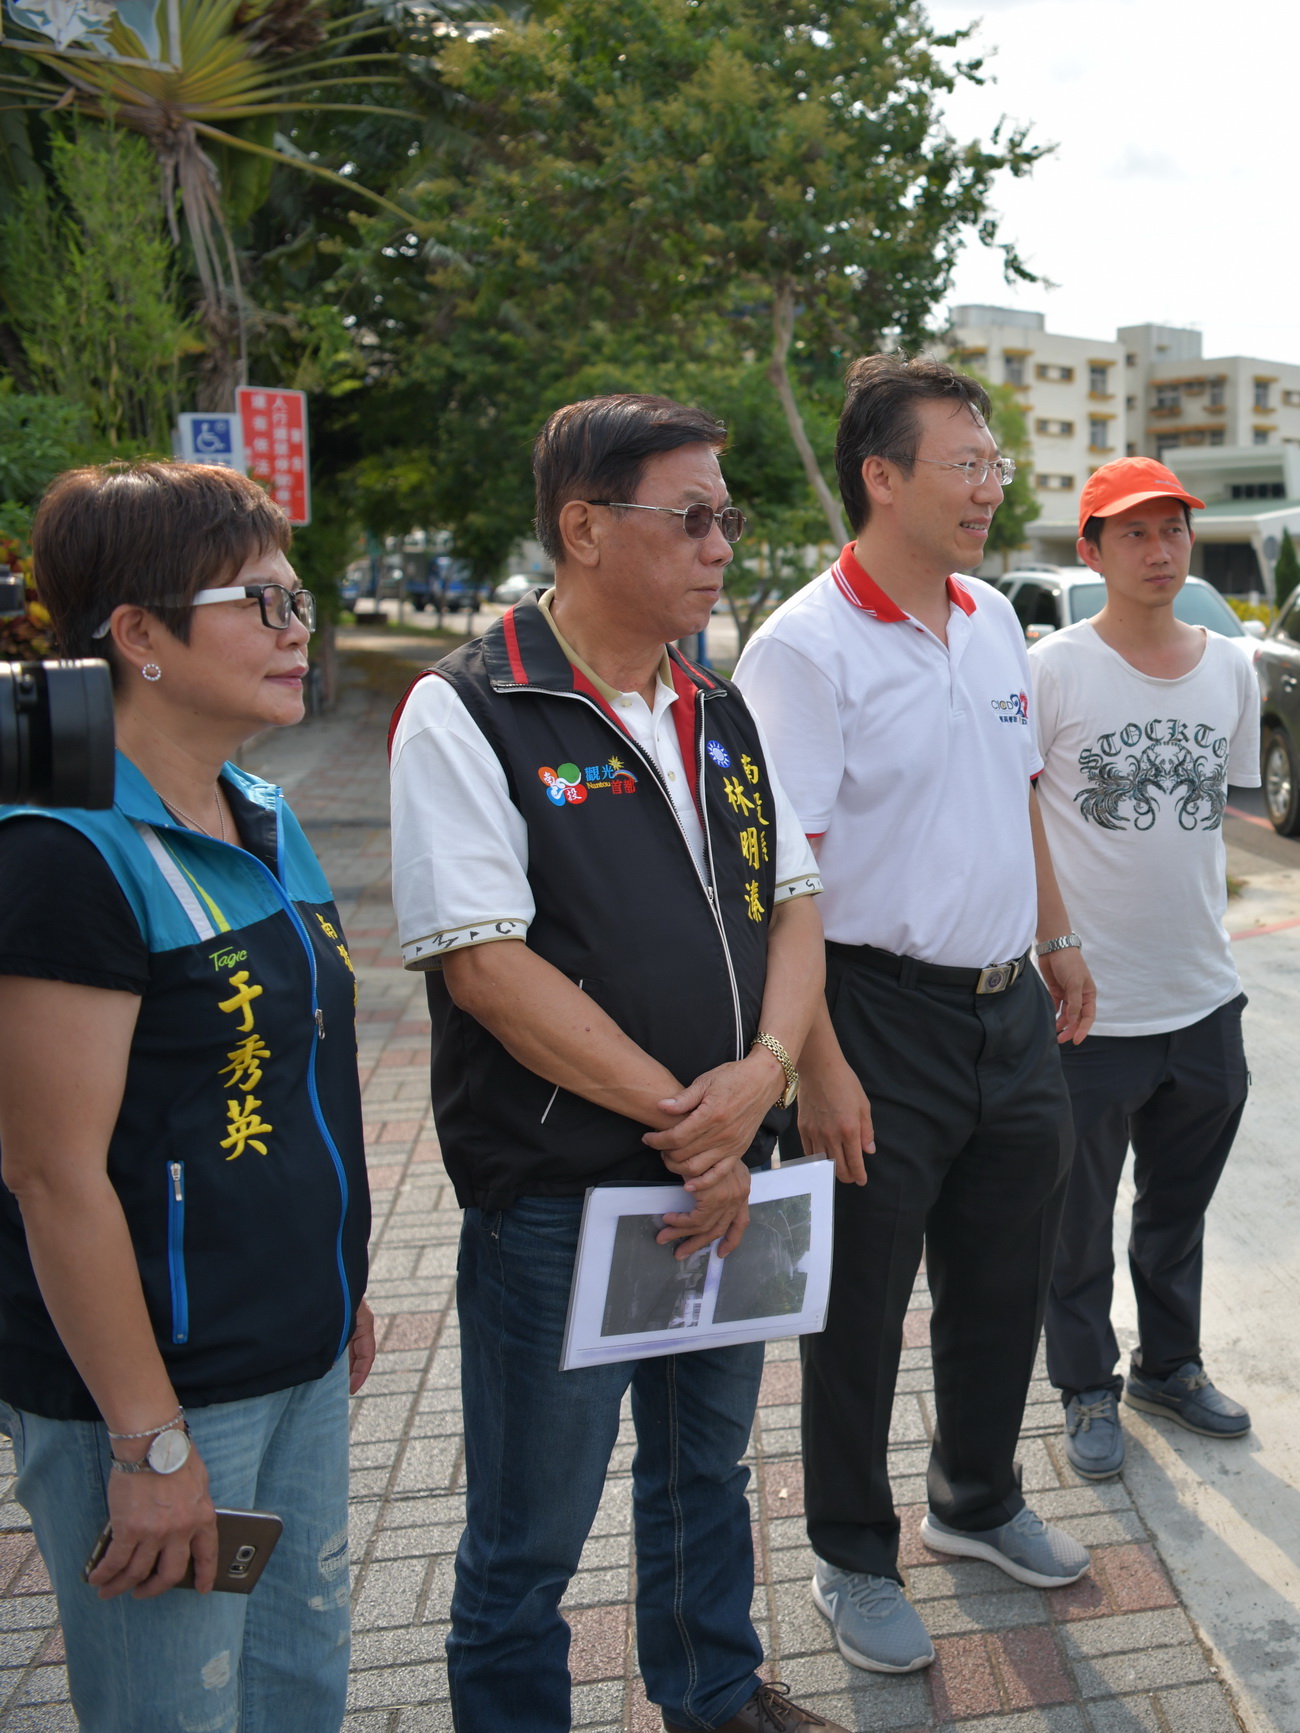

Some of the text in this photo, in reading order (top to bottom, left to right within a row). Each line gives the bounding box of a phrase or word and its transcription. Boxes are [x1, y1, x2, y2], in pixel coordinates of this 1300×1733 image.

[1078, 718, 1229, 775] STOCKTO
[584, 764, 615, 782] 觀光
[586, 781, 612, 790] Nantou
[611, 779, 637, 796] 首都
[217, 970, 273, 1161] 于秀英
